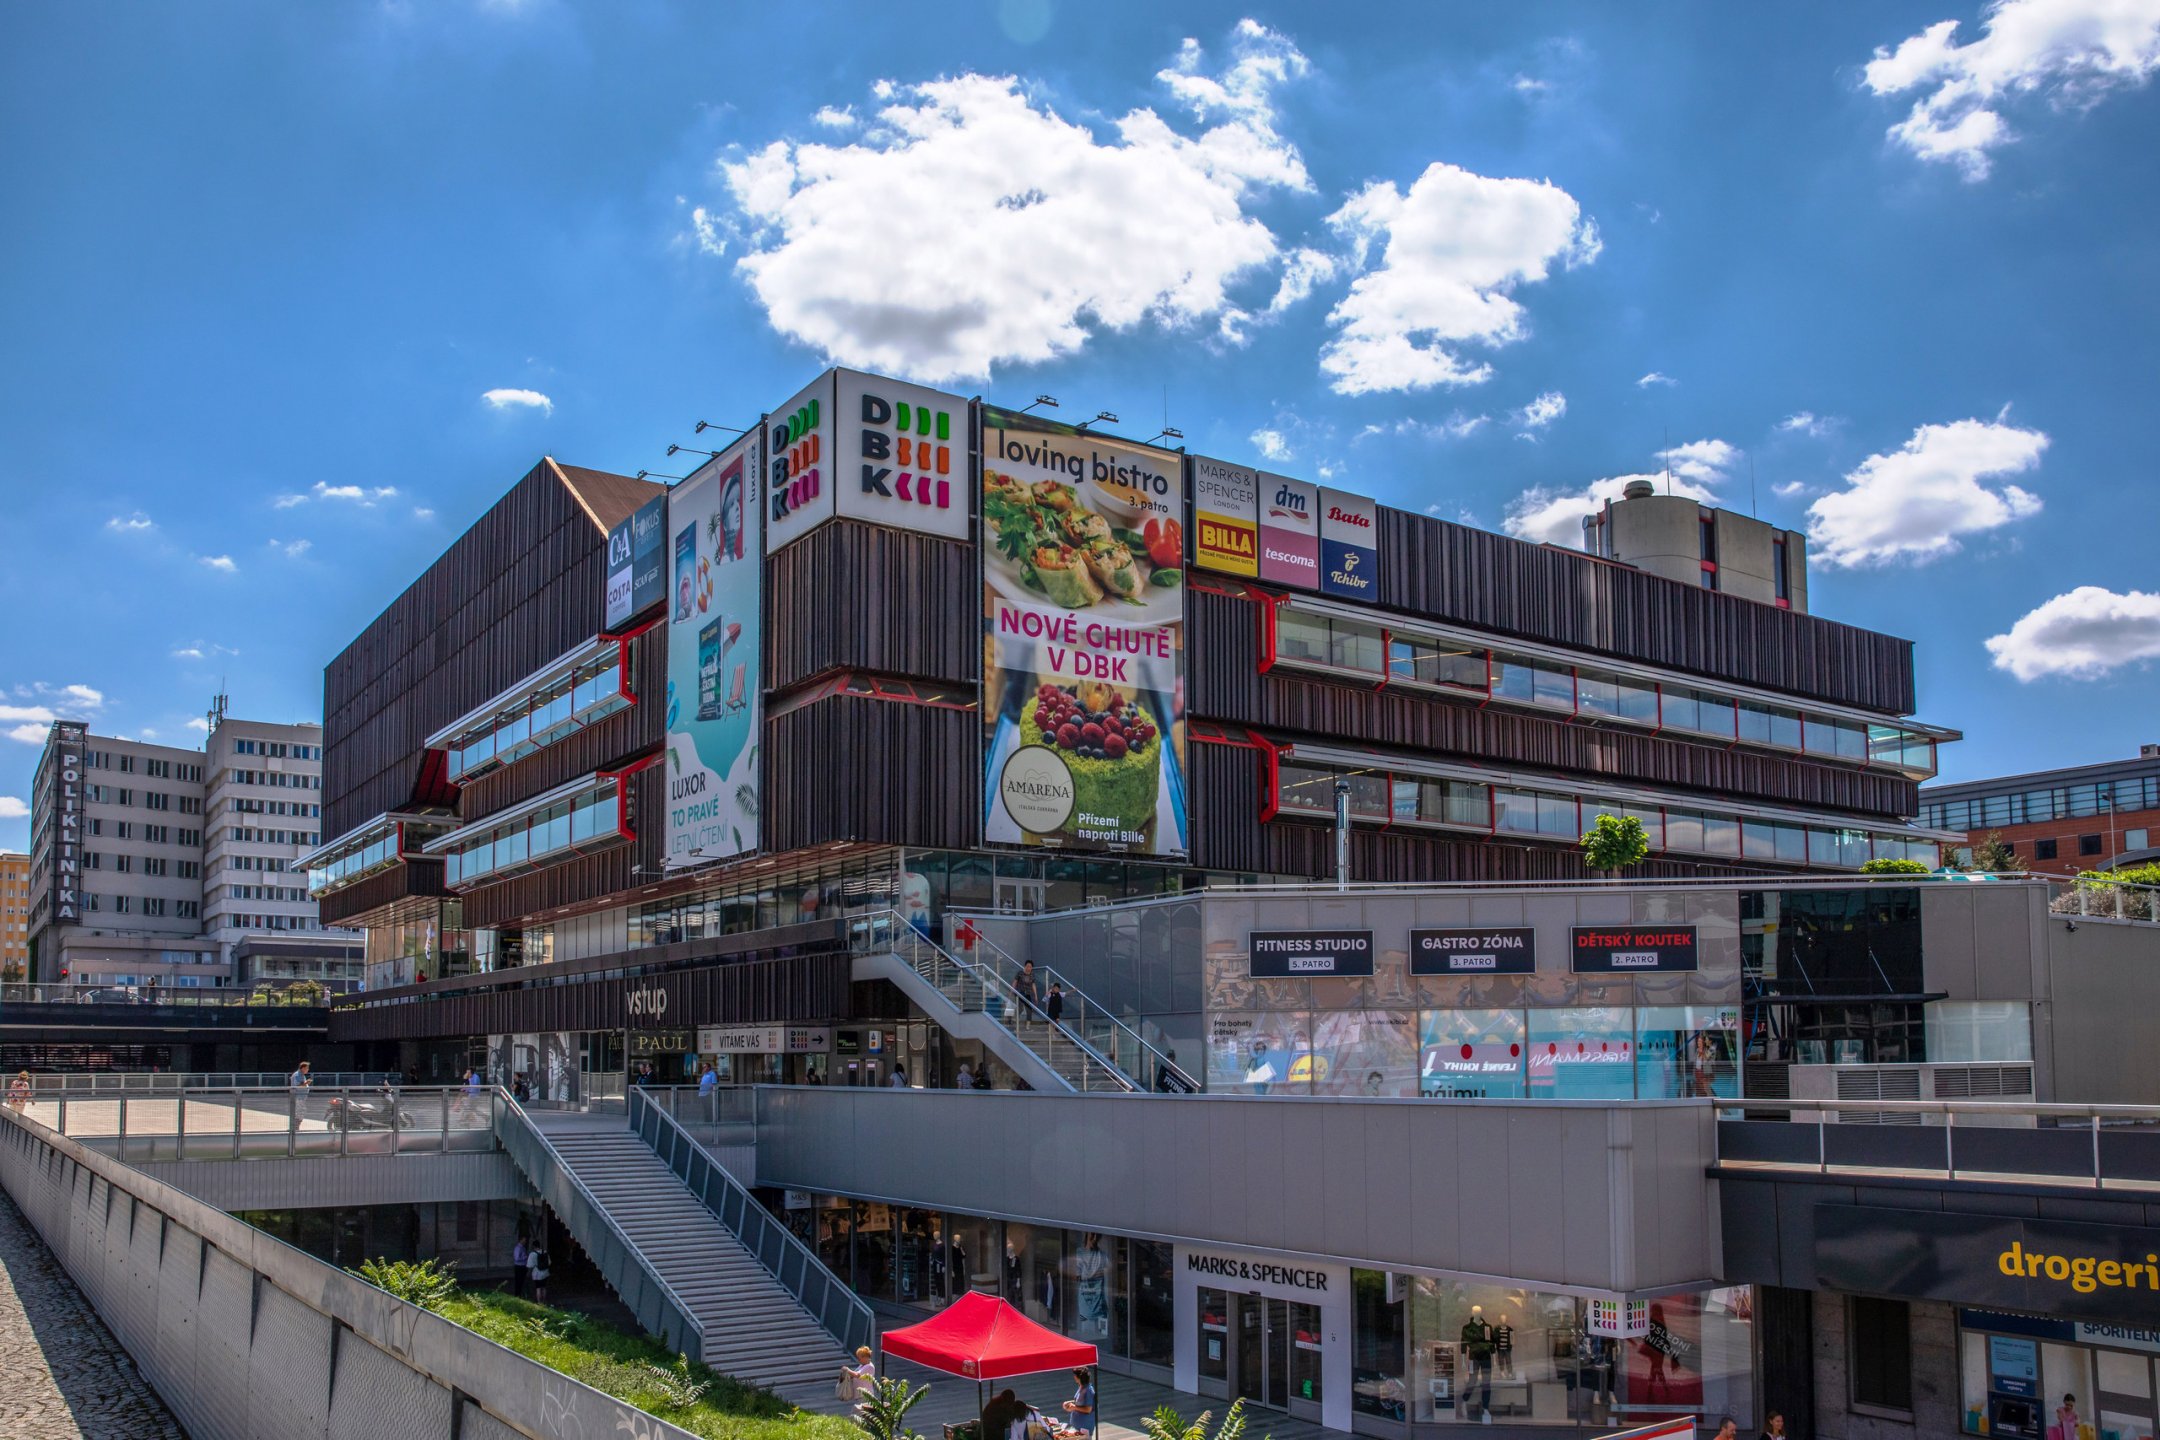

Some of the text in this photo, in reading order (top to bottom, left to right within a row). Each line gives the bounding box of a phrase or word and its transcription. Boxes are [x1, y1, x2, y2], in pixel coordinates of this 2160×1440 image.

[999, 429, 1168, 495] loving bistro
[1200, 464, 1251, 487] MARKS &
[1129, 496, 1168, 513] 3. patro
[1199, 480, 1254, 504] SPENCER
[1276, 484, 1306, 511] dm
[1213, 500, 1240, 511] LONDON
[635, 509, 660, 540] FOKUS
[609, 528, 631, 567] C&A
[1202, 525, 1252, 554] BILLA
[1331, 570, 1369, 588] Tchibo
[608, 580, 630, 605] COSTA
[1001, 607, 1170, 658] NOVÉ CHUTĚ
[1048, 646, 1127, 682] V DBK
[672, 772, 706, 800] LUXOR
[1006, 780, 1070, 799] AMARENA
[672, 793, 719, 828] TO PRAVÉ
[1078, 813, 1119, 827] Přízemí
[59, 754, 79, 918] POLIKLINIKA
[700, 818, 728, 847] ČTENÍ
[1078, 829, 1145, 843] naproti Bille
[1256, 939, 1367, 952] FITNESS STUDIO
[1422, 934, 1523, 949] GASTRO ZÓNA
[1578, 932, 1691, 947] DĚTSKÝ KOUTEK
[1453, 958, 1492, 966] 3. PATRO
[1615, 956, 1655, 964] 2. PATRO
[626, 983, 667, 1020] vstup
[638, 1036, 687, 1050] PAUL
[719, 1032, 744, 1048] VÍTÁME
[746, 1031, 760, 1048] VÁS
[1188, 1254, 1328, 1291] MARKS & SPENCER
[1998, 1241, 2160, 1293] drogeri
[1650, 1323, 1690, 1352] OSLEDNÍ
